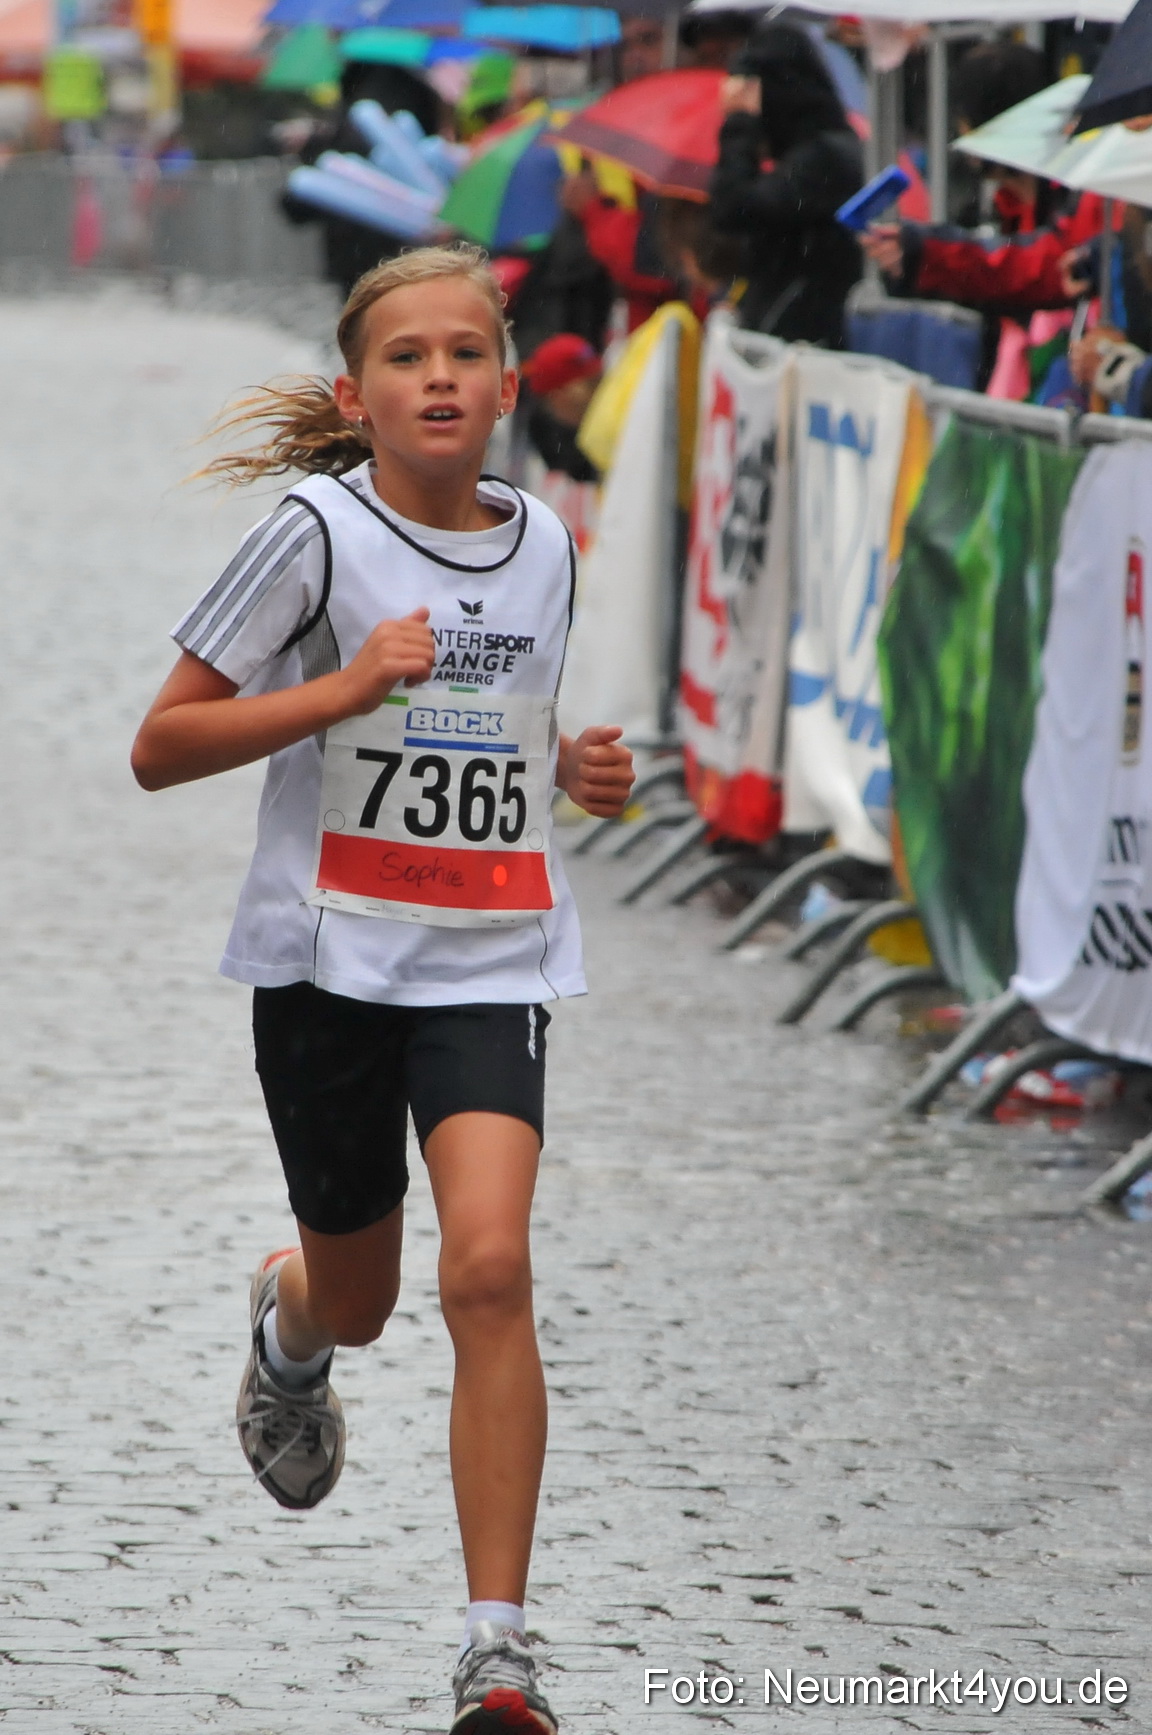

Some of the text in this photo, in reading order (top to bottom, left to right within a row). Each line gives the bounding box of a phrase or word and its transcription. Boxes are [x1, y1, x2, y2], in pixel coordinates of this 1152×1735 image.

[430, 627, 535, 654] NTERSPORT
[433, 650, 516, 673] ANGE
[433, 670, 494, 685] AMBERG
[405, 707, 504, 736] BOCK
[356, 747, 526, 844] 7365
[379, 852, 464, 887] Sophie
